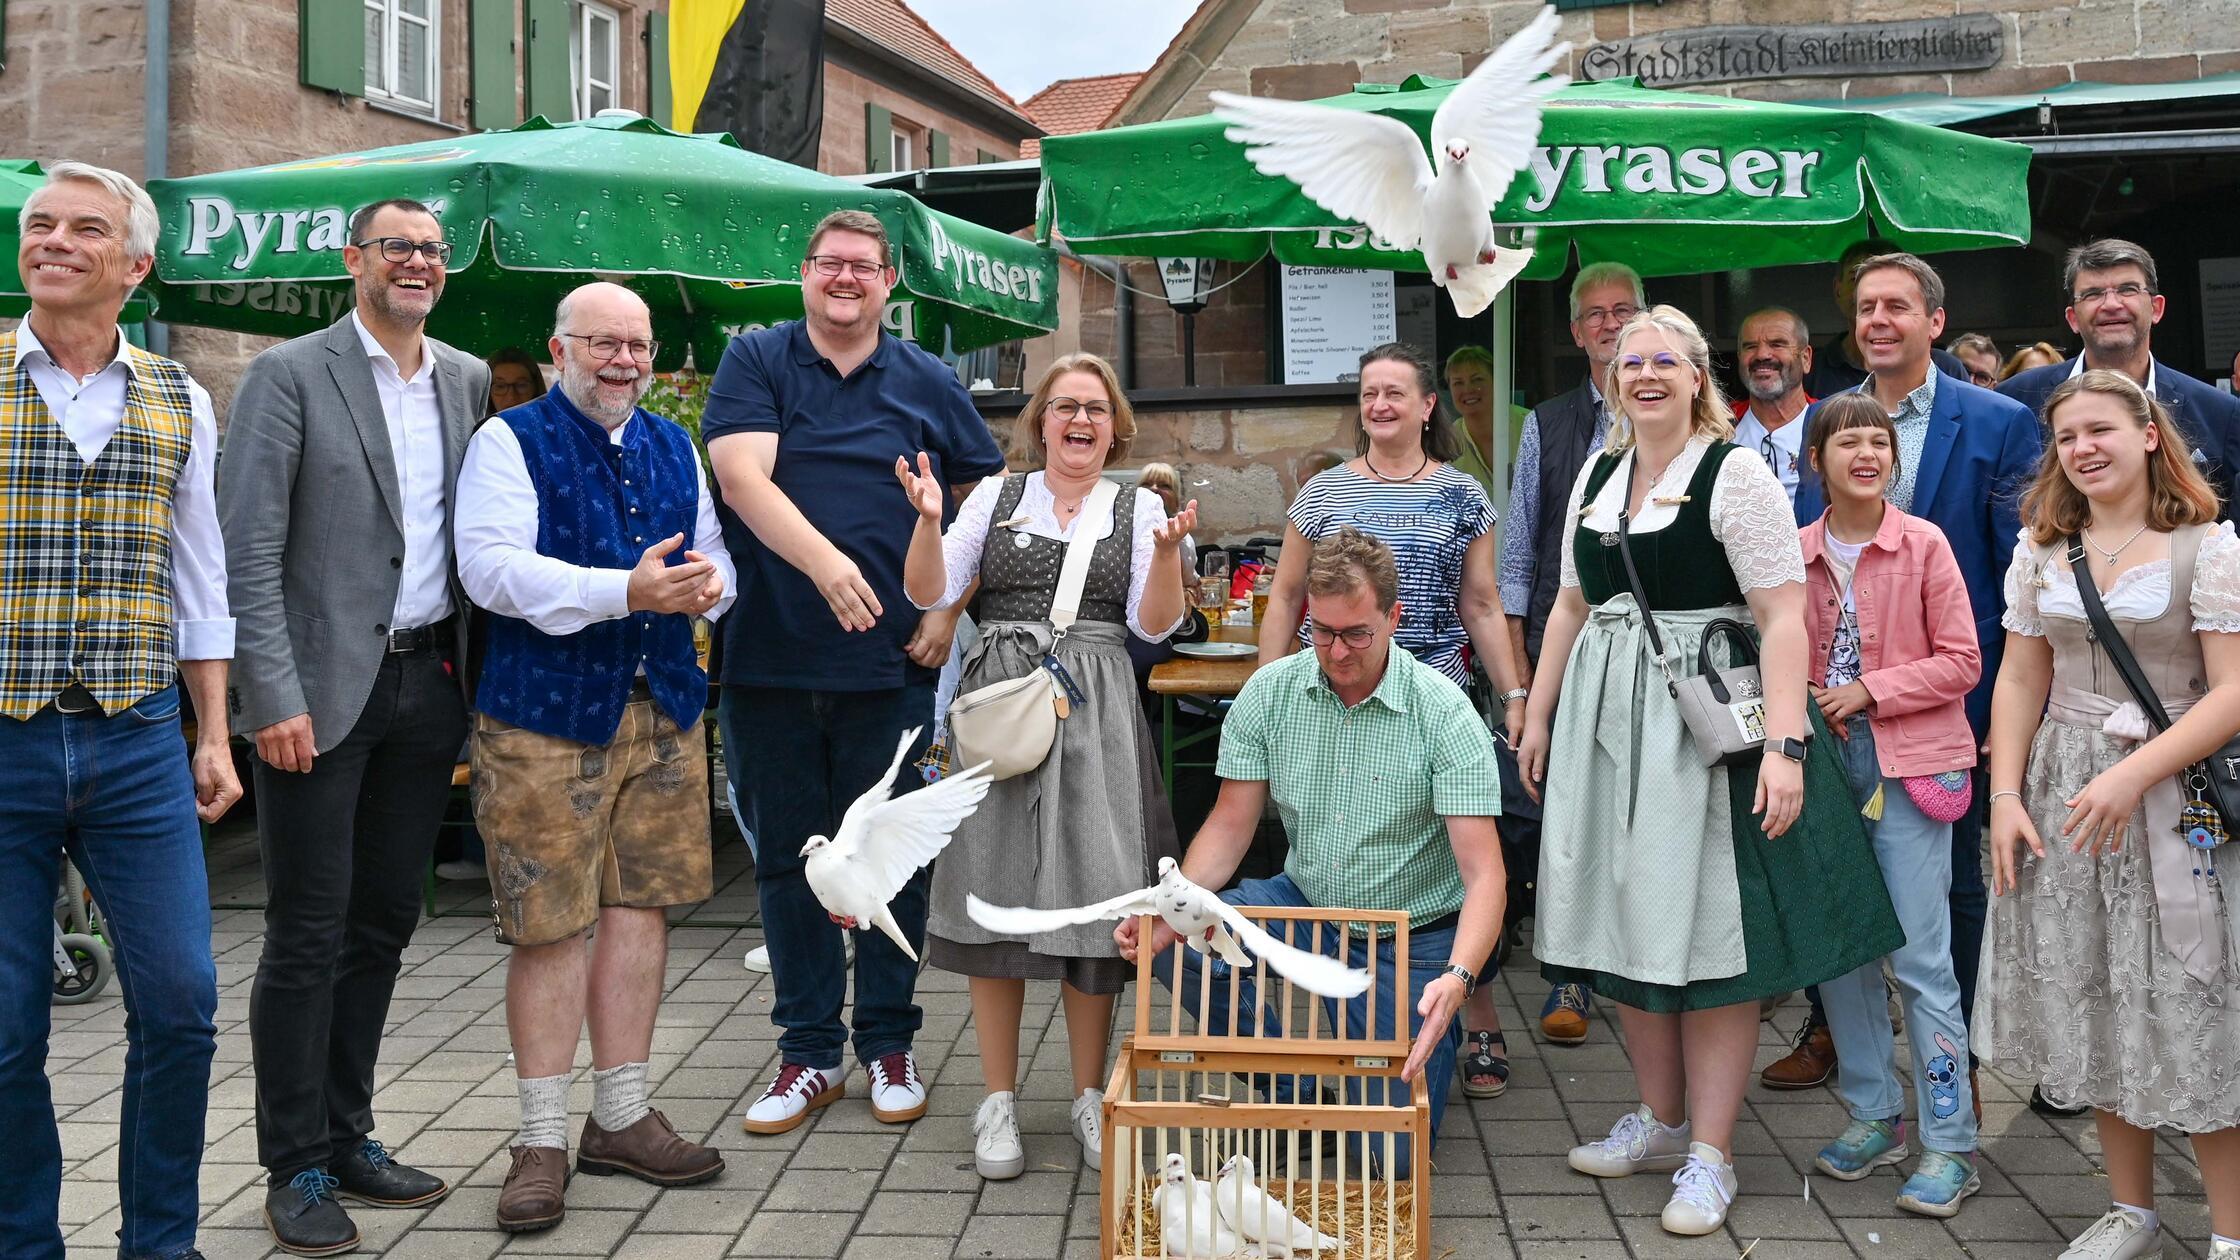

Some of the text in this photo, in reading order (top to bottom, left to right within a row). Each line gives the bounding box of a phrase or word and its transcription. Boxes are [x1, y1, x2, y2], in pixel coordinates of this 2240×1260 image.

[1524, 144, 1821, 213] yraser
[185, 197, 445, 270] Pyra
[927, 215, 1044, 303] Pyraser
